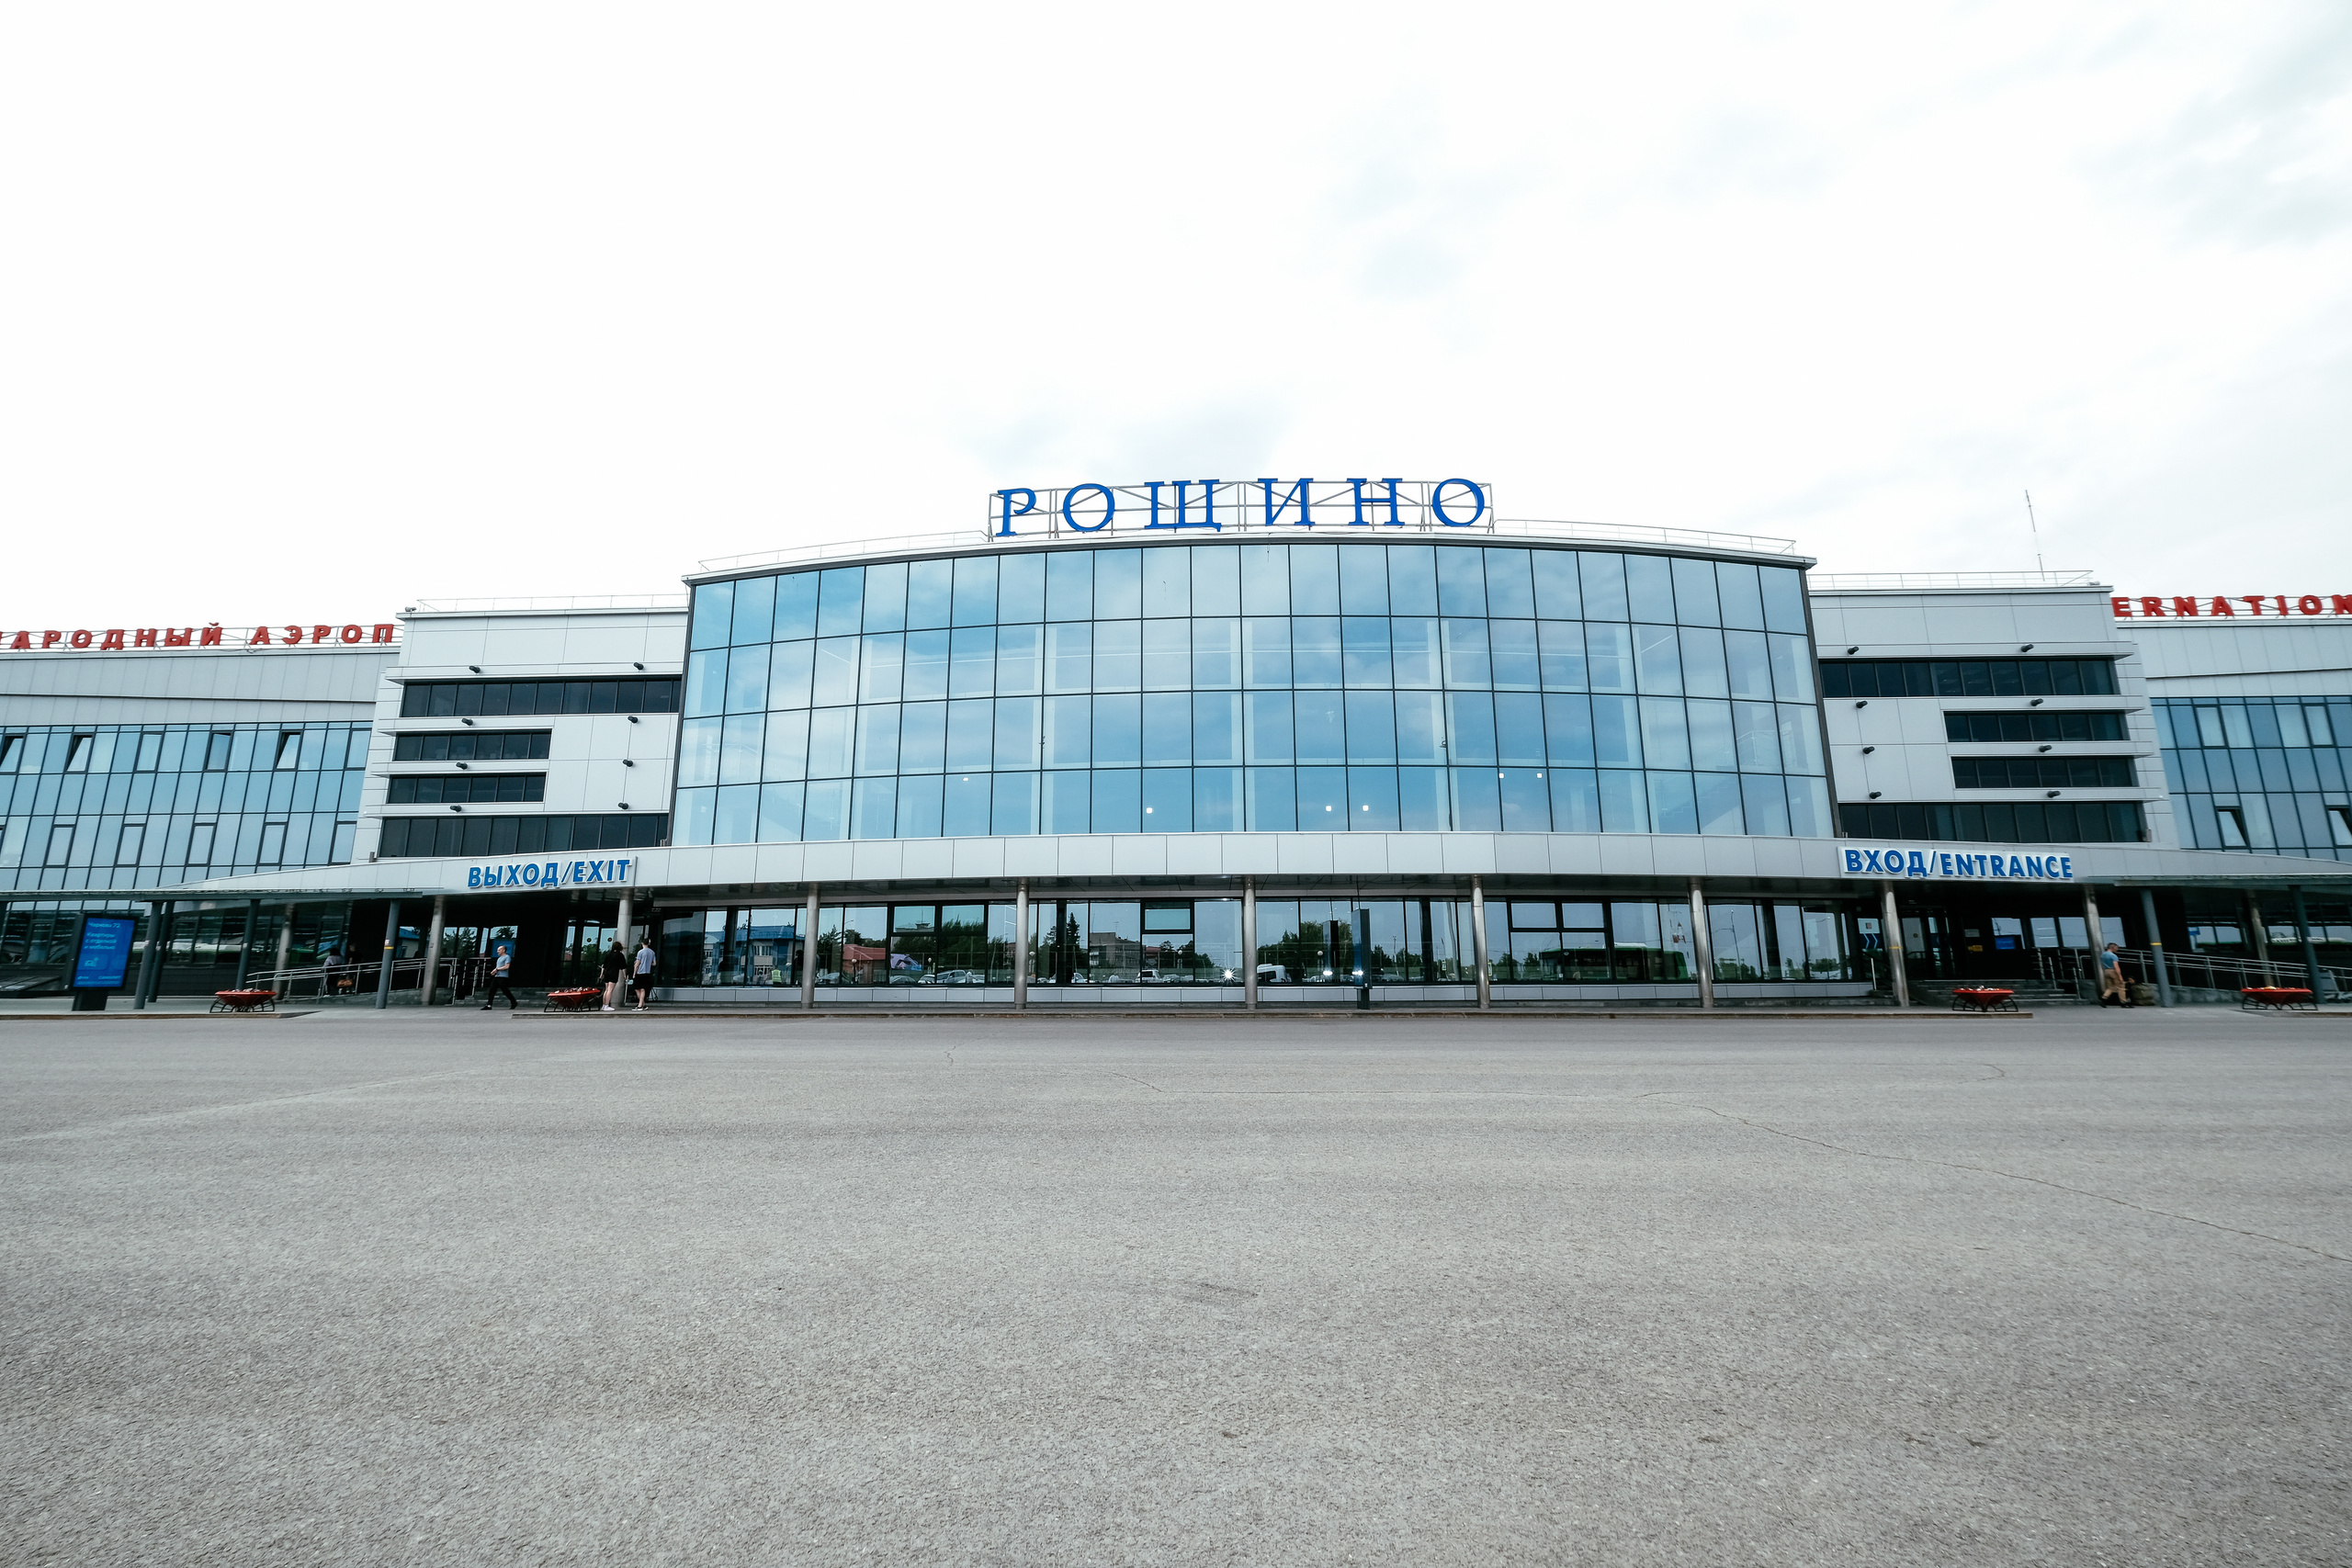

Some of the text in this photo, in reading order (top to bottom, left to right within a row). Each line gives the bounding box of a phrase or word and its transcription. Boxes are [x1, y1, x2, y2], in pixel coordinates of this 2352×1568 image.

[995, 477, 1486, 537] РОЩИНО
[2110, 594, 2352, 617] ERNATION
[0, 622, 394, 651] АРОДНЫЙ АЭРОП
[468, 859, 630, 888] ВЫХОД/EXIT
[1845, 850, 2074, 878] ВХОД/ENTRANCE
